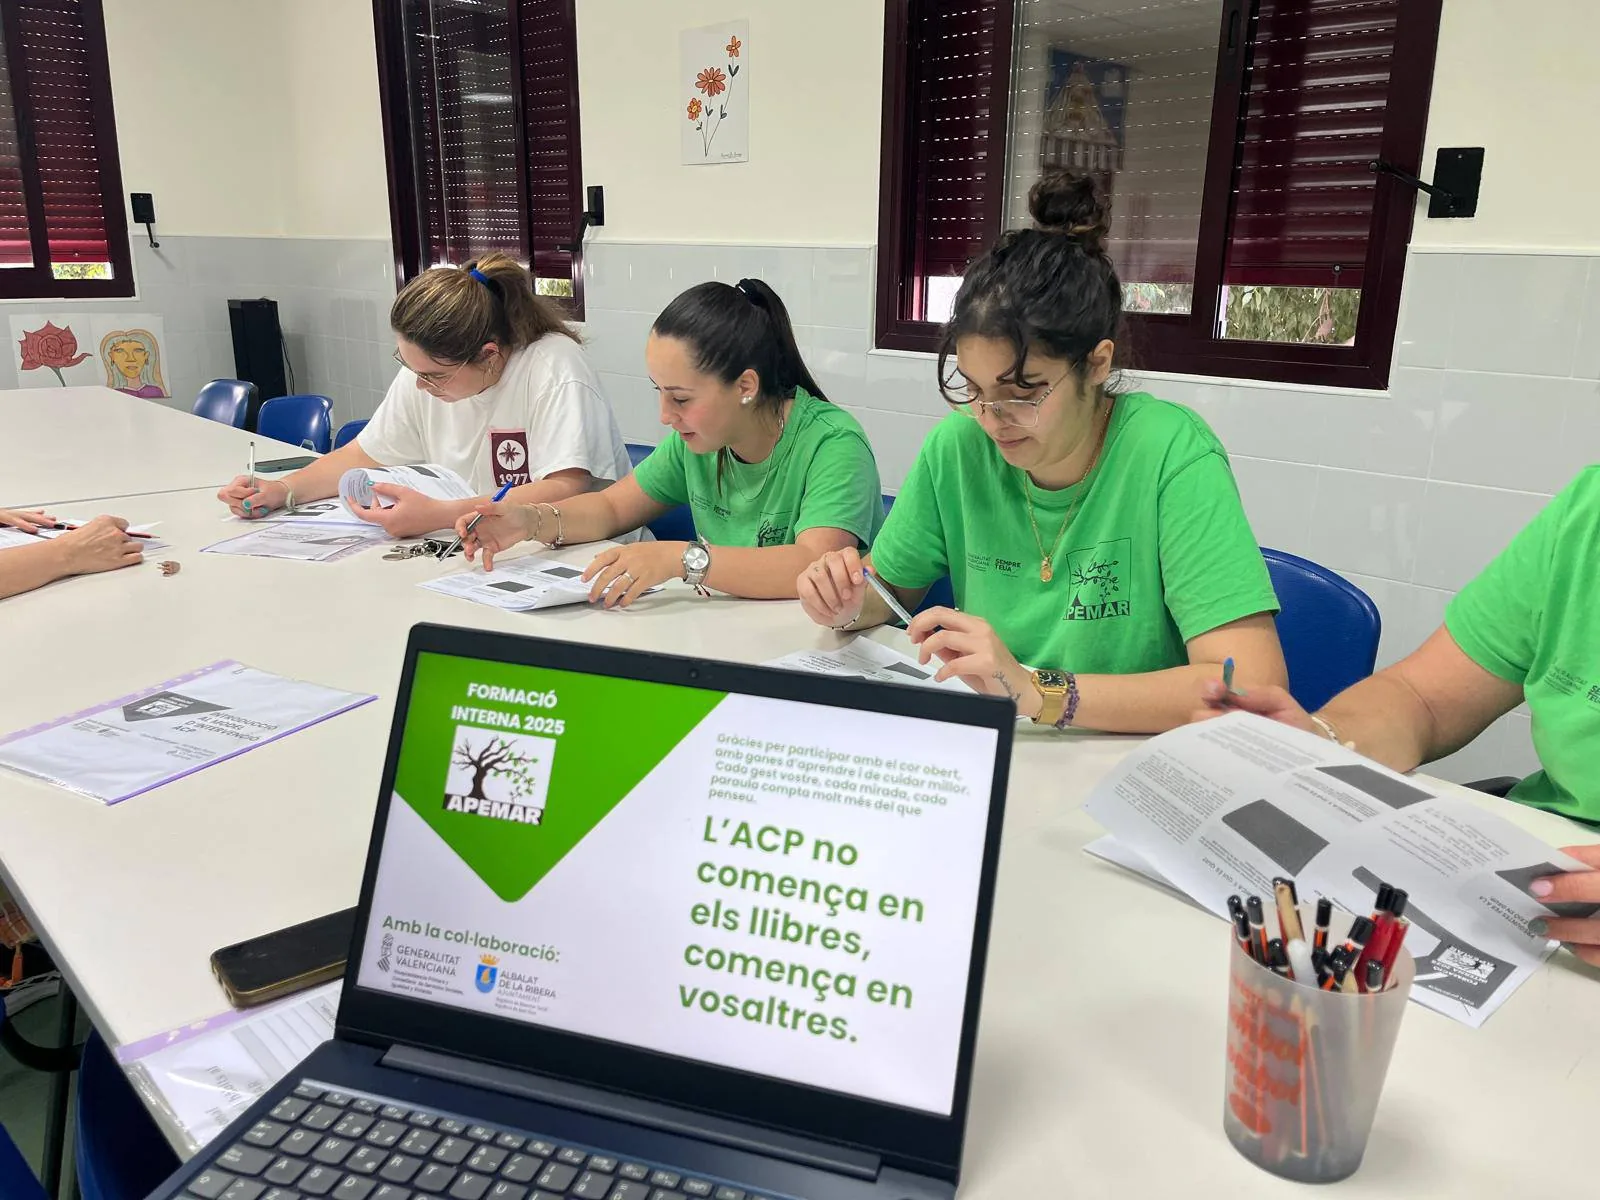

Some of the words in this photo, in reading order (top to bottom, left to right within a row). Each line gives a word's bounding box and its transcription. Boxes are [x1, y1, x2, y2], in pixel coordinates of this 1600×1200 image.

[499, 473, 528, 485] 1977
[1063, 601, 1130, 620] PEMAR
[467, 682, 558, 708] FORMACIÓ
[451, 705, 521, 729] INTERNA
[524, 716, 565, 735] 2025
[717, 733, 763, 749] Gràcies
[765, 739, 785, 753] per
[788, 741, 850, 763] participar
[853, 754, 883, 768] amb
[886, 757, 897, 769] el
[900, 762, 920, 773] cor
[923, 764, 962, 780] obert,
[715, 748, 743, 761] amb
[746, 754, 784, 768] ganes
[786, 756, 855, 778] d'aprendre
[857, 766, 862, 776] i
[865, 767, 881, 780] de
[883, 770, 925, 787] cuidar
[927, 778, 970, 795] millor.
[715, 761, 748, 775] Cada
[750, 767, 778, 781] gest
[780, 771, 820, 786] vostre,
[825, 775, 857, 791] cada
[859, 781, 910, 801] mirada,
[913, 791, 947, 806] cada
[708, 789, 757, 804] penseu.
[711, 774, 759, 790] paraula
[761, 782, 810, 799] compta
[812, 788, 842, 803] molt
[844, 793, 871, 808] més
[874, 798, 894, 811] del
[897, 804, 922, 817] que
[447, 795, 542, 825] APEMAR
[703, 815, 804, 855] L'ACP
[812, 838, 858, 865] no
[697, 861, 868, 917] comença
[878, 894, 924, 922] en
[382, 915, 421, 935] Amb
[425, 923, 440, 939] la
[444, 929, 560, 963] col·laboració:
[691, 899, 740, 931] els
[750, 906, 871, 961] llibres,
[395, 956, 457, 977] VALENCIANA
[397, 945, 461, 966] GENERALITAT
[499, 979, 510, 989] DE
[513, 983, 522, 991] LA
[525, 985, 556, 997] RIBERA
[500, 971, 539, 984] ALBALAT
[684, 944, 856, 1001] comença
[867, 979, 913, 1009] en
[679, 984, 857, 1043] vosaltres.
[326, 1141, 340, 1149] W
[356, 1147, 370, 1158] E
[275, 1160, 288, 1169] A
[427, 1166, 438, 1175] T
[343, 1176, 357, 1187] D
[462, 1175, 473, 1184] Y
